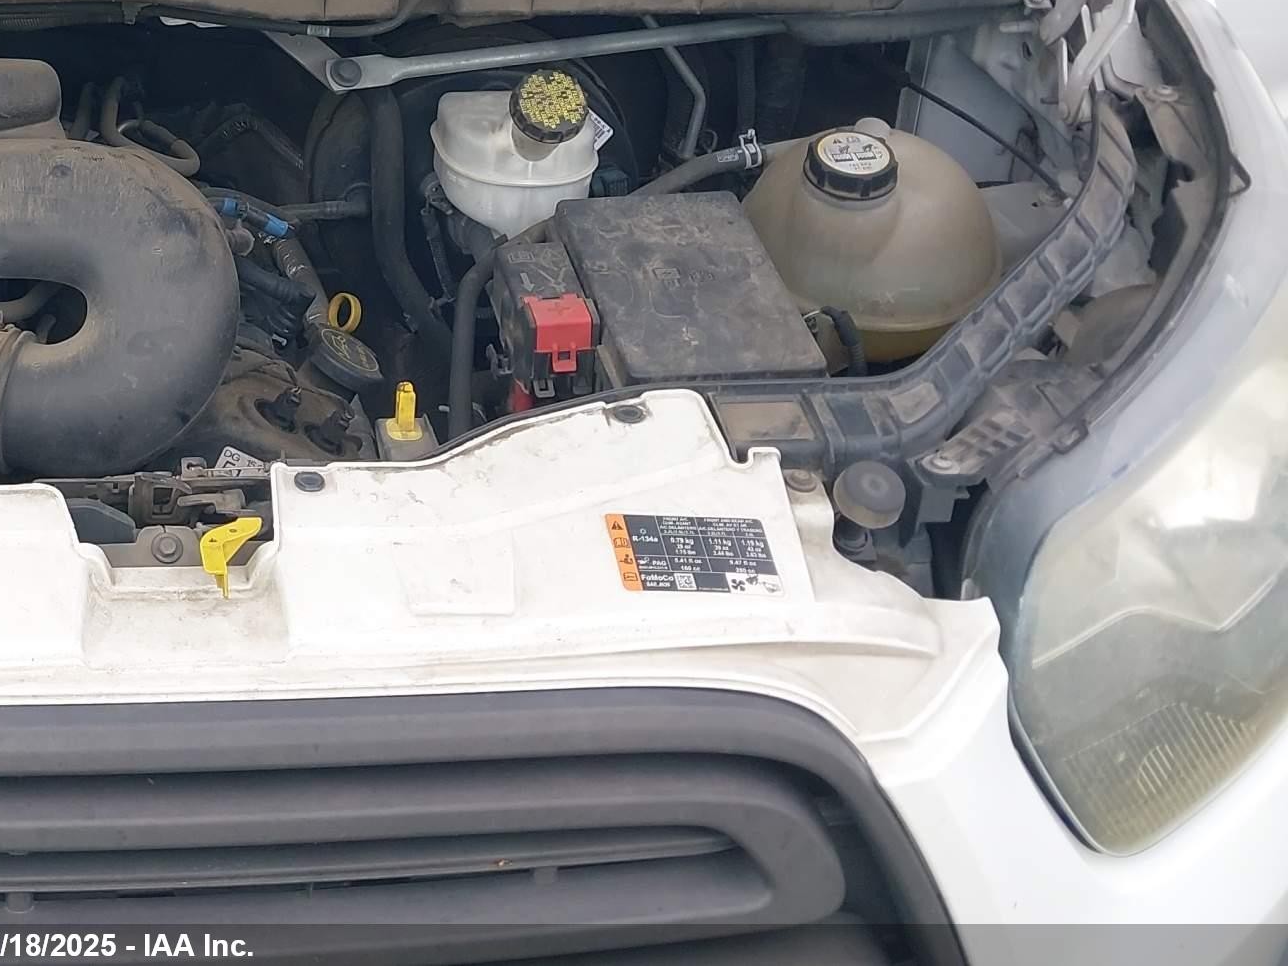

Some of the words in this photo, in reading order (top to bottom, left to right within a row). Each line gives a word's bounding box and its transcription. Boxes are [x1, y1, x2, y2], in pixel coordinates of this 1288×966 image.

[224, 449, 241, 462] DG
[723, 538, 732, 546] kg
[755, 540, 764, 548] kg
